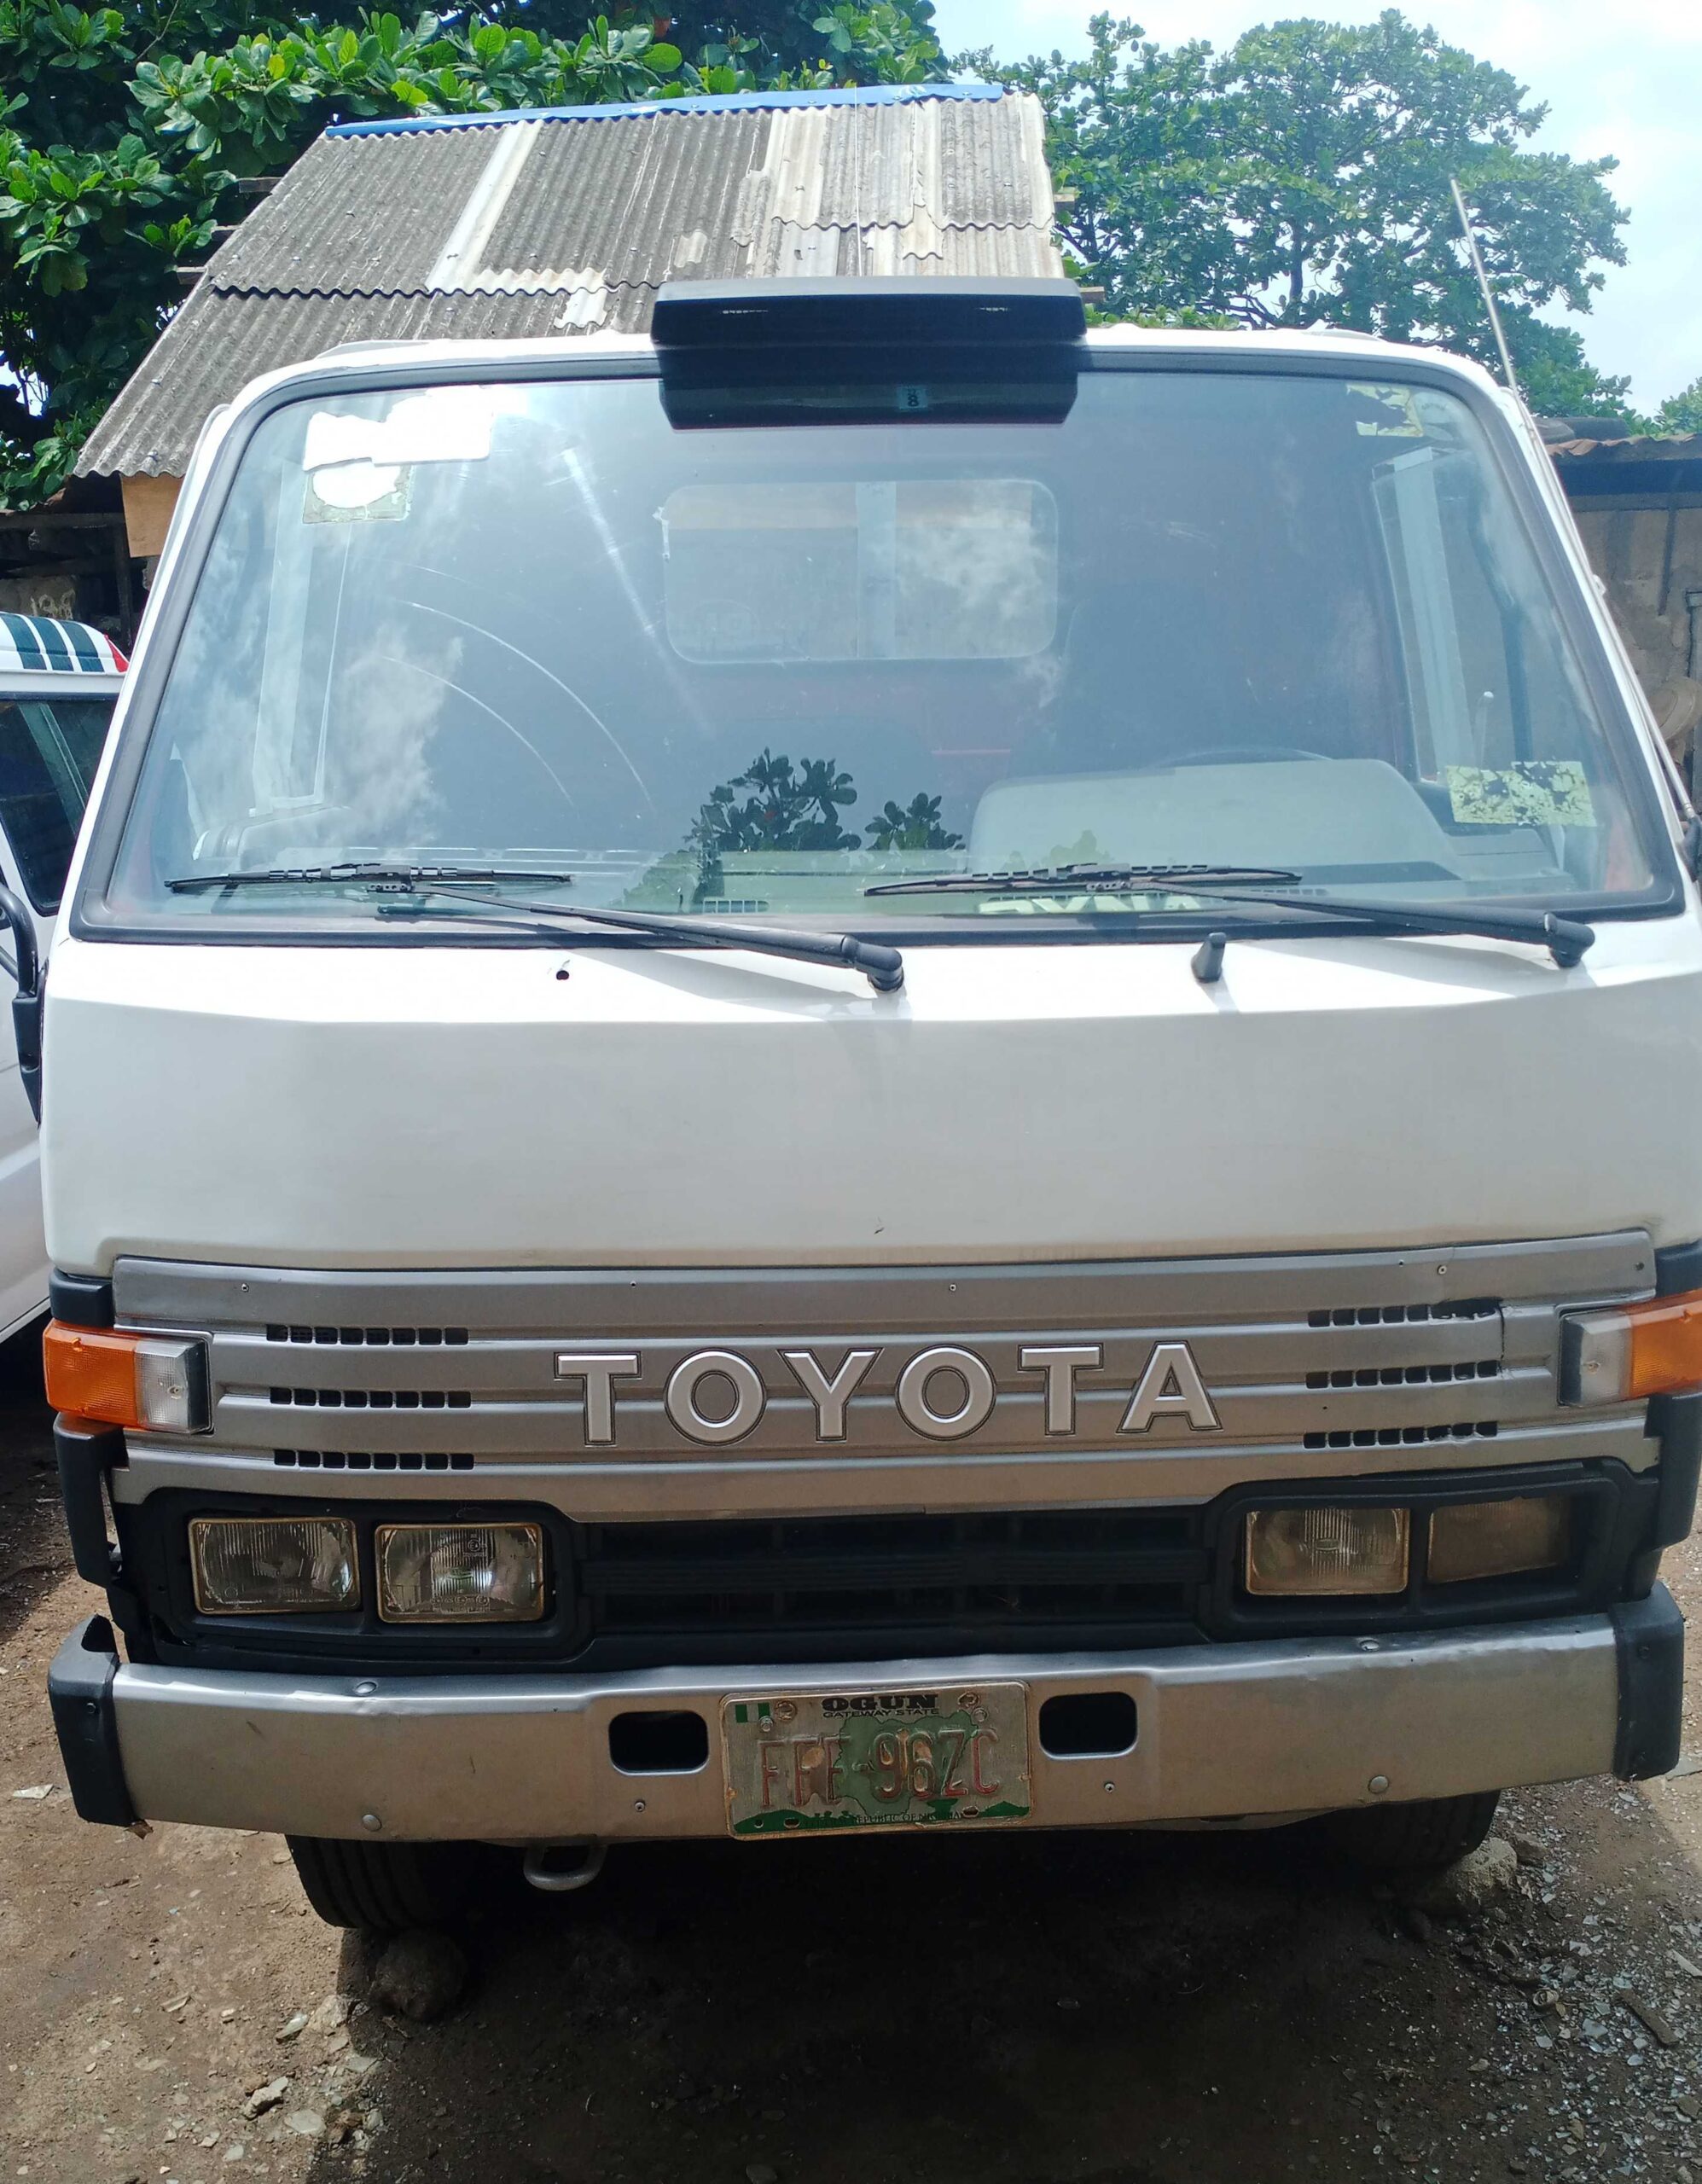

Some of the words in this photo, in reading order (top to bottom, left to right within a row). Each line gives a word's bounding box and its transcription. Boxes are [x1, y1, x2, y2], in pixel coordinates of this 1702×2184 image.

[553, 1339, 1224, 1447] TOYOTA
[822, 1693, 938, 1711] OGUN
[822, 1710, 892, 1718] GATEWAY
[918, 1810, 960, 1822] NIGIA
